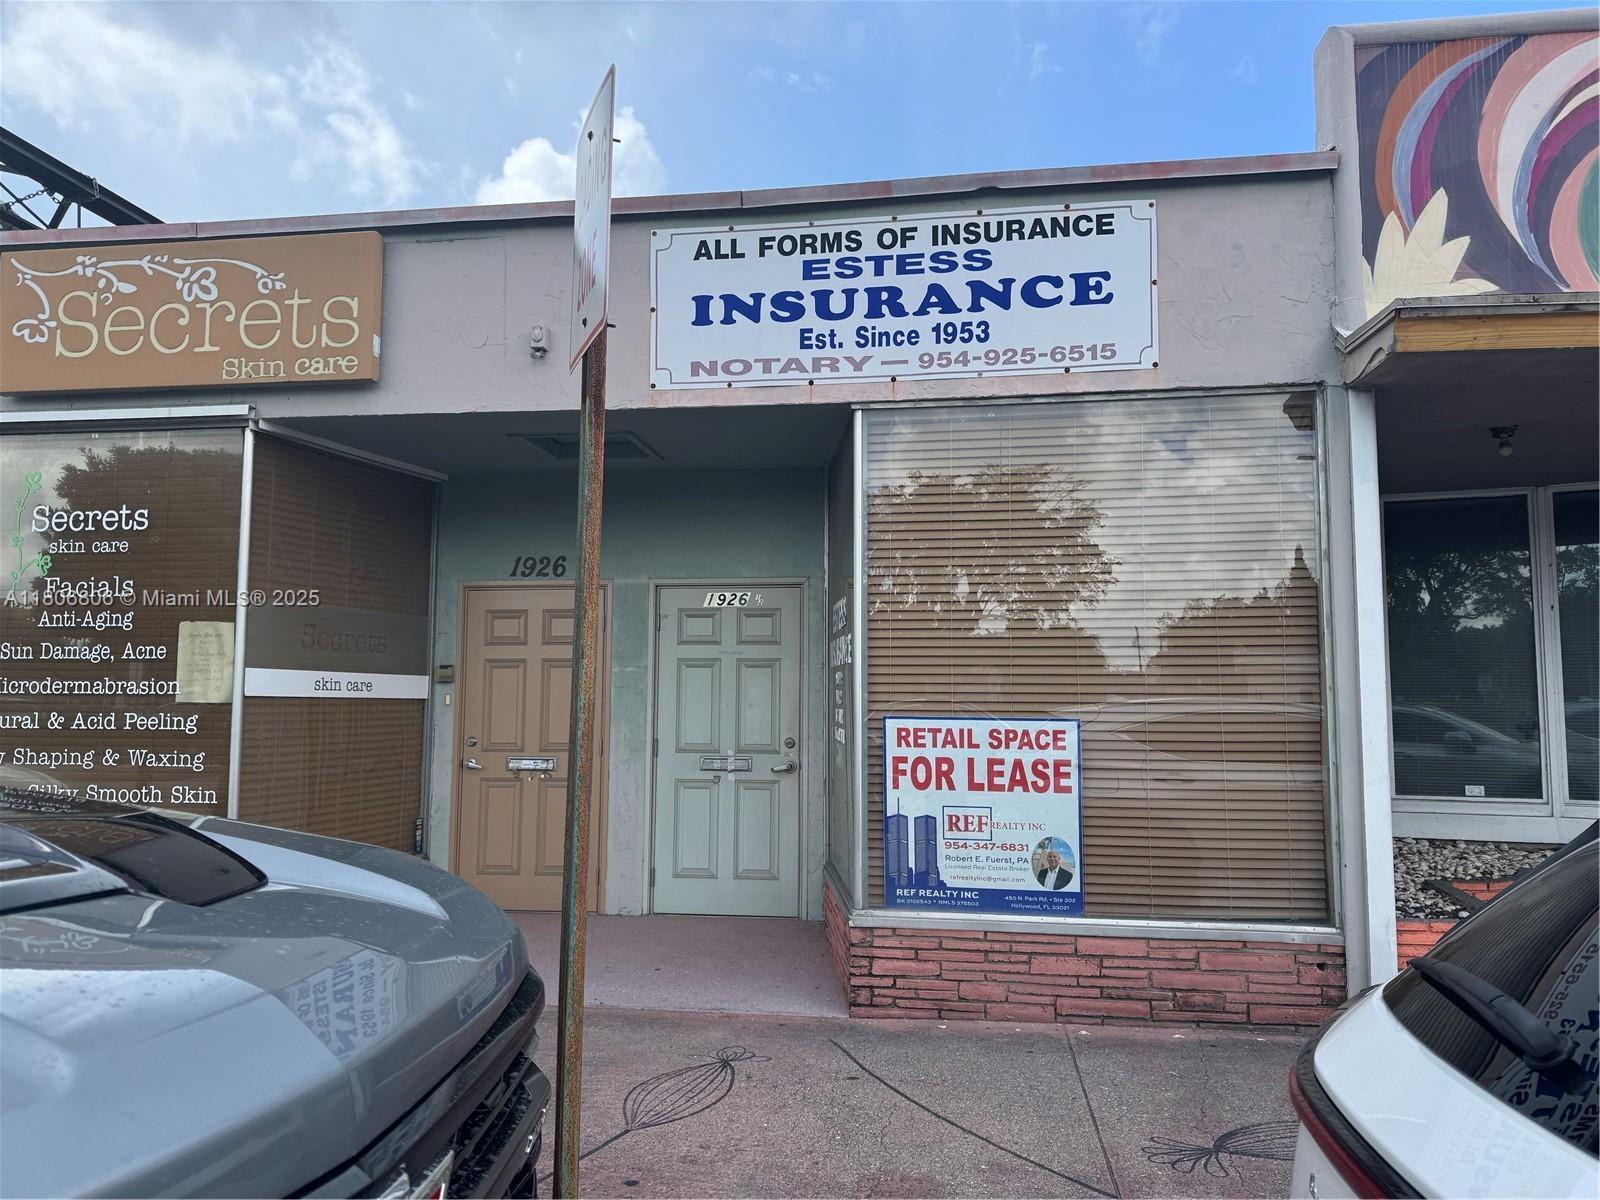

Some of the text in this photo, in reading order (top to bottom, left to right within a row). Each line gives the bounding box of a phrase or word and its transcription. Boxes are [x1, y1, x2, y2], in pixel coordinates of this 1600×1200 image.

[694, 213, 1115, 261] ALL FORMS OF INSURANCE
[801, 248, 993, 281] ESTESS
[690, 270, 1114, 326] INSURANCE
[55, 288, 360, 358] Secrets
[799, 320, 991, 350] Est. Since 1953
[222, 354, 358, 380] Skin care
[689, 355, 875, 377] NOTARY
[918, 343, 1117, 369] 954-925-6515
[31, 504, 150, 533] Secrets
[49, 539, 129, 554] skin care
[509, 555, 567, 577] 1926
[45, 576, 134, 600] Facials
[706, 592, 749, 606] 1926
[37, 610, 134, 631] Anti-Aging
[302, 624, 389, 654] Secrets
[0, 643, 167, 663] Sun Damage, Acne
[0, 677, 181, 695] icrodermabrasion
[314, 677, 373, 692] skin care
[0, 712, 199, 734] ural & Acid Peeling
[896, 727, 1066, 750] RETAIL SPACE
[13, 748, 95, 769] Shaping
[102, 749, 120, 766] &
[128, 749, 205, 771] Waxing
[892, 756, 1072, 794] FOR LEASE
[86, 784, 164, 804] Smooth
[171, 785, 218, 805] Skin
[946, 814, 1046, 833] REF REALTY INC
[944, 841, 1029, 852] 954-347-6831
[945, 854, 973, 863] Robert
[975, 855, 984, 863] E.
[986, 856, 1015, 865] Fuerst,
[919, 890, 958, 898] REALTY
[960, 891, 979, 899] INC
[1010, 903, 1043, 911] Hollywood,
